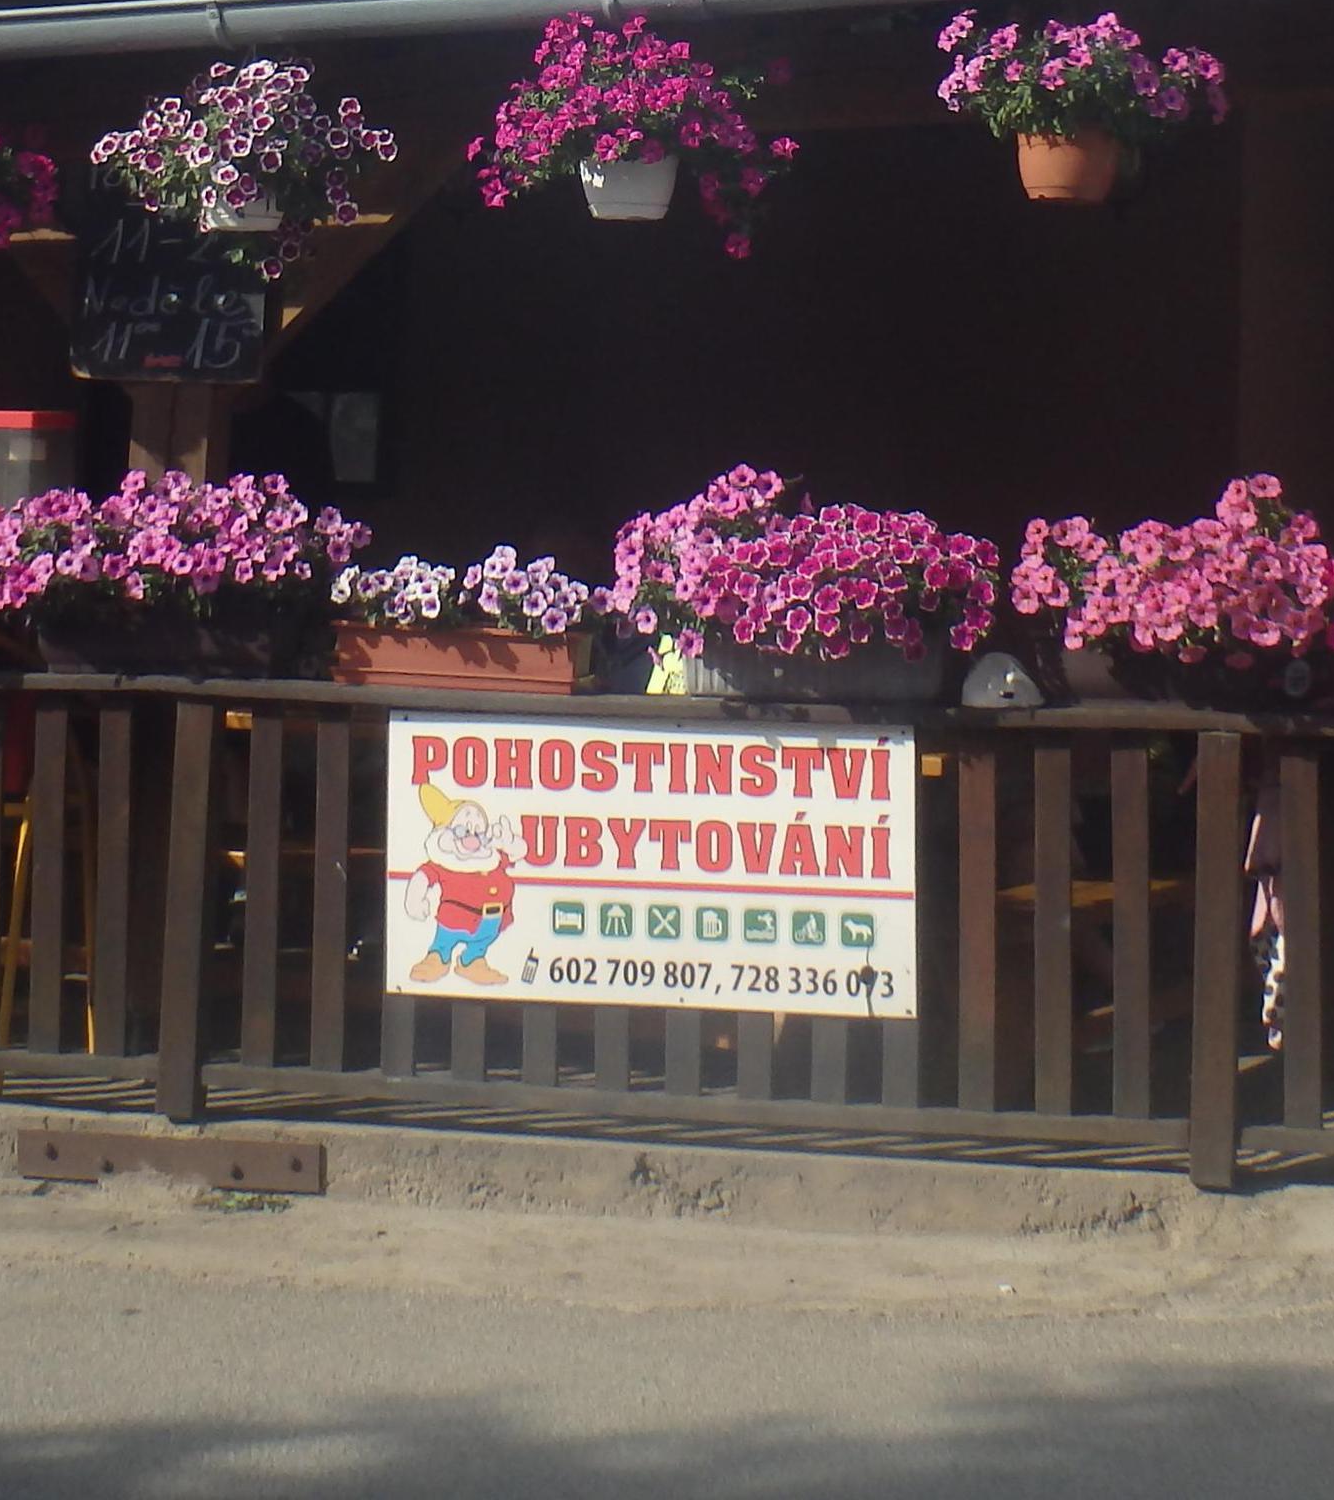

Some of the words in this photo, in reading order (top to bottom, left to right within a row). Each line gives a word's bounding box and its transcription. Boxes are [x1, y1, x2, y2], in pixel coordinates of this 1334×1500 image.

[411, 734, 892, 801] POHOSTINSTVÍ
[520, 810, 892, 880] UBYTOVÁNÍ
[549, 956, 598, 986] 602
[607, 958, 656, 987] 709
[663, 960, 722, 996] 807,
[730, 963, 780, 993] 728
[787, 966, 838, 996] 336
